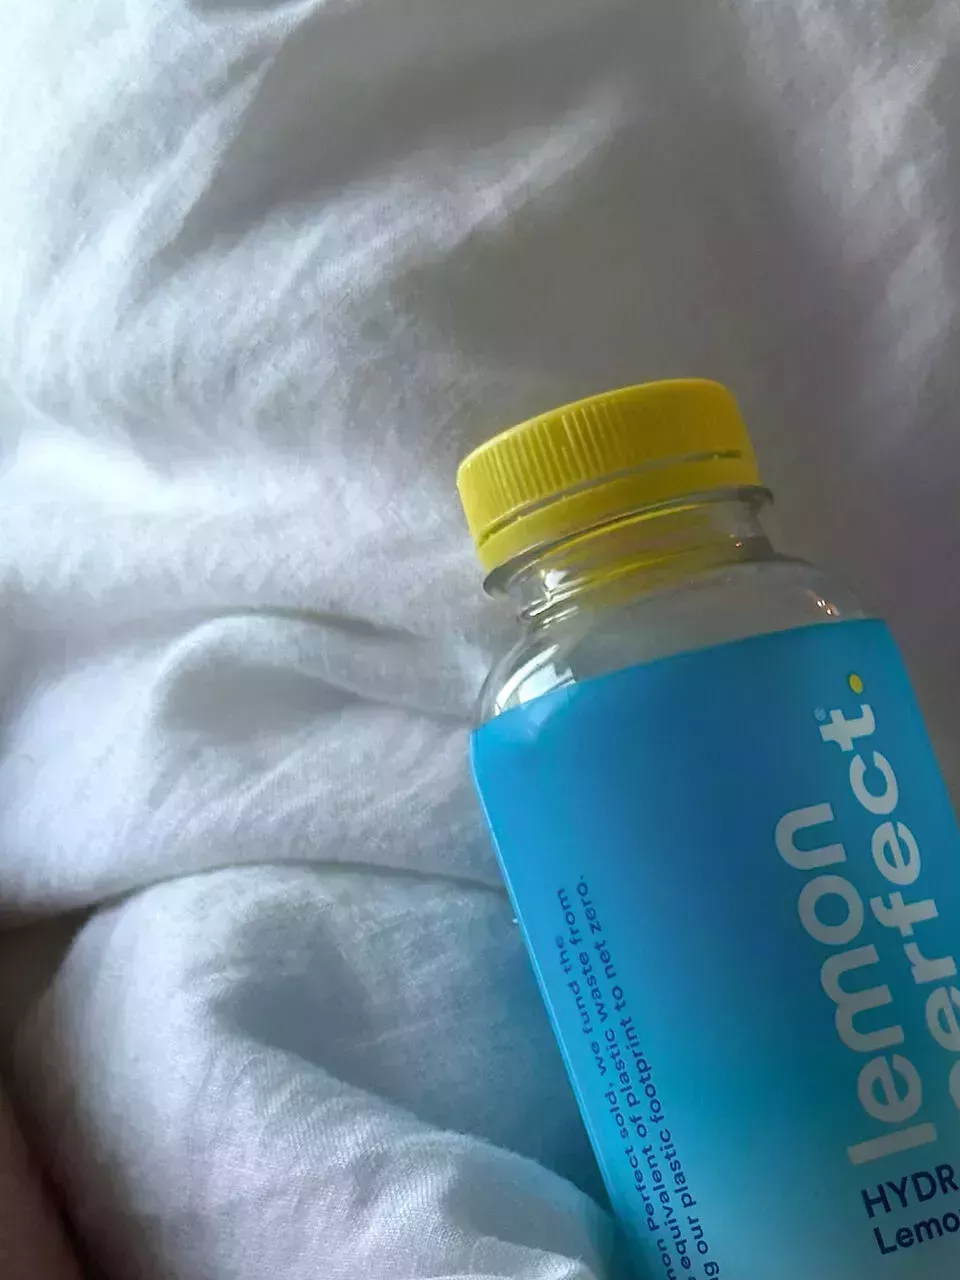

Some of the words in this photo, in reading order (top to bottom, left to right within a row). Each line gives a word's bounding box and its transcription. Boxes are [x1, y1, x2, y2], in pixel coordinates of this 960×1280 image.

[557, 888, 583, 945] from
[576, 875, 603, 935] zero.
[555, 935, 572, 975] the
[594, 939, 617, 979] net
[567, 980, 594, 1035] fund
[579, 951, 608, 1023] waste
[611, 985, 627, 1012] to
[775, 802, 938, 1166] lemon
[591, 1041, 607, 1076] we
[605, 1028, 641, 1108] plastic
[619, 1015, 665, 1124] footprint
[605, 1082, 629, 1139] sold,
[629, 1115, 647, 1138] of
[625, 1145, 660, 1232] Perfect
[659, 1128, 697, 1208] plastic
[641, 1144, 691, 1270] equivalent
[687, 1215, 709, 1255] our
